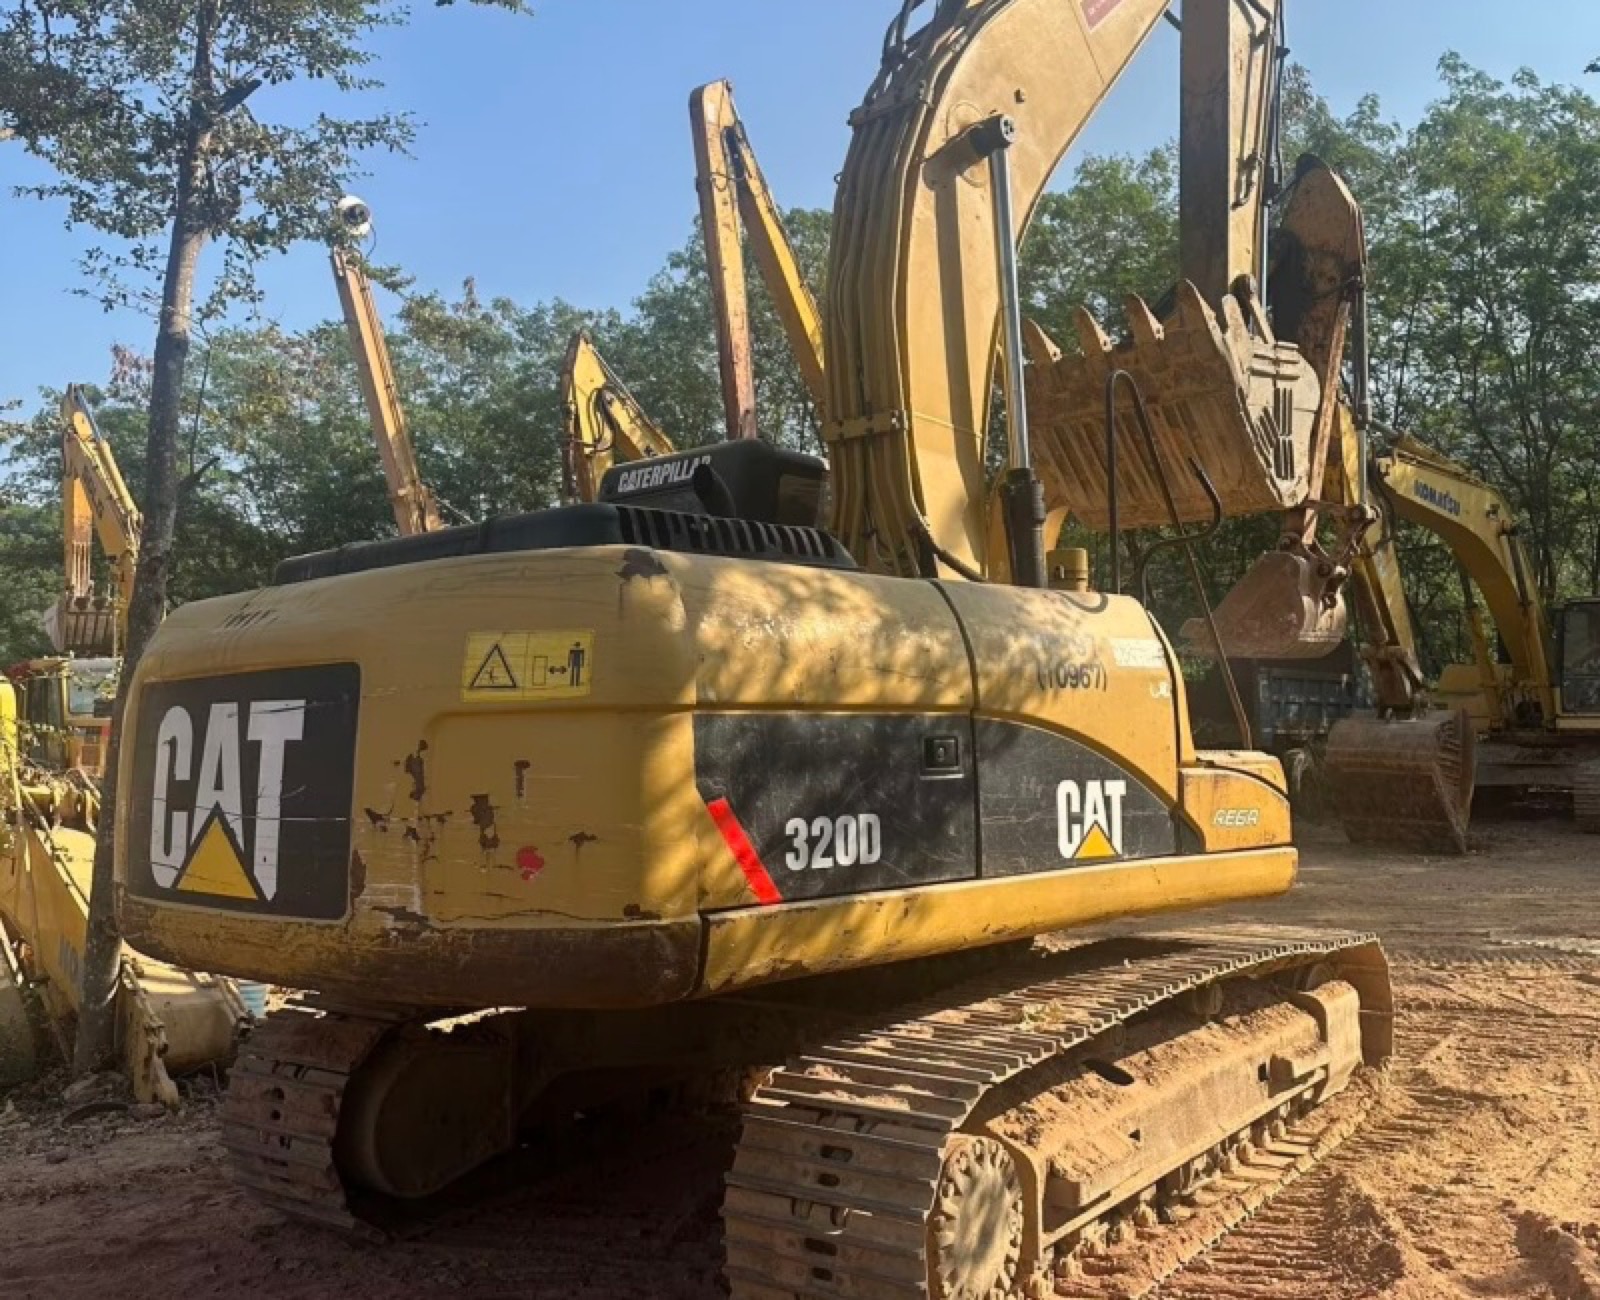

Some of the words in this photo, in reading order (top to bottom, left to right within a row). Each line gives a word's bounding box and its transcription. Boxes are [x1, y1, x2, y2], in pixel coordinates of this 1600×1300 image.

[149, 699, 306, 901] CAT
[1056, 779, 1126, 859] CAT
[785, 813, 881, 871] 320D
